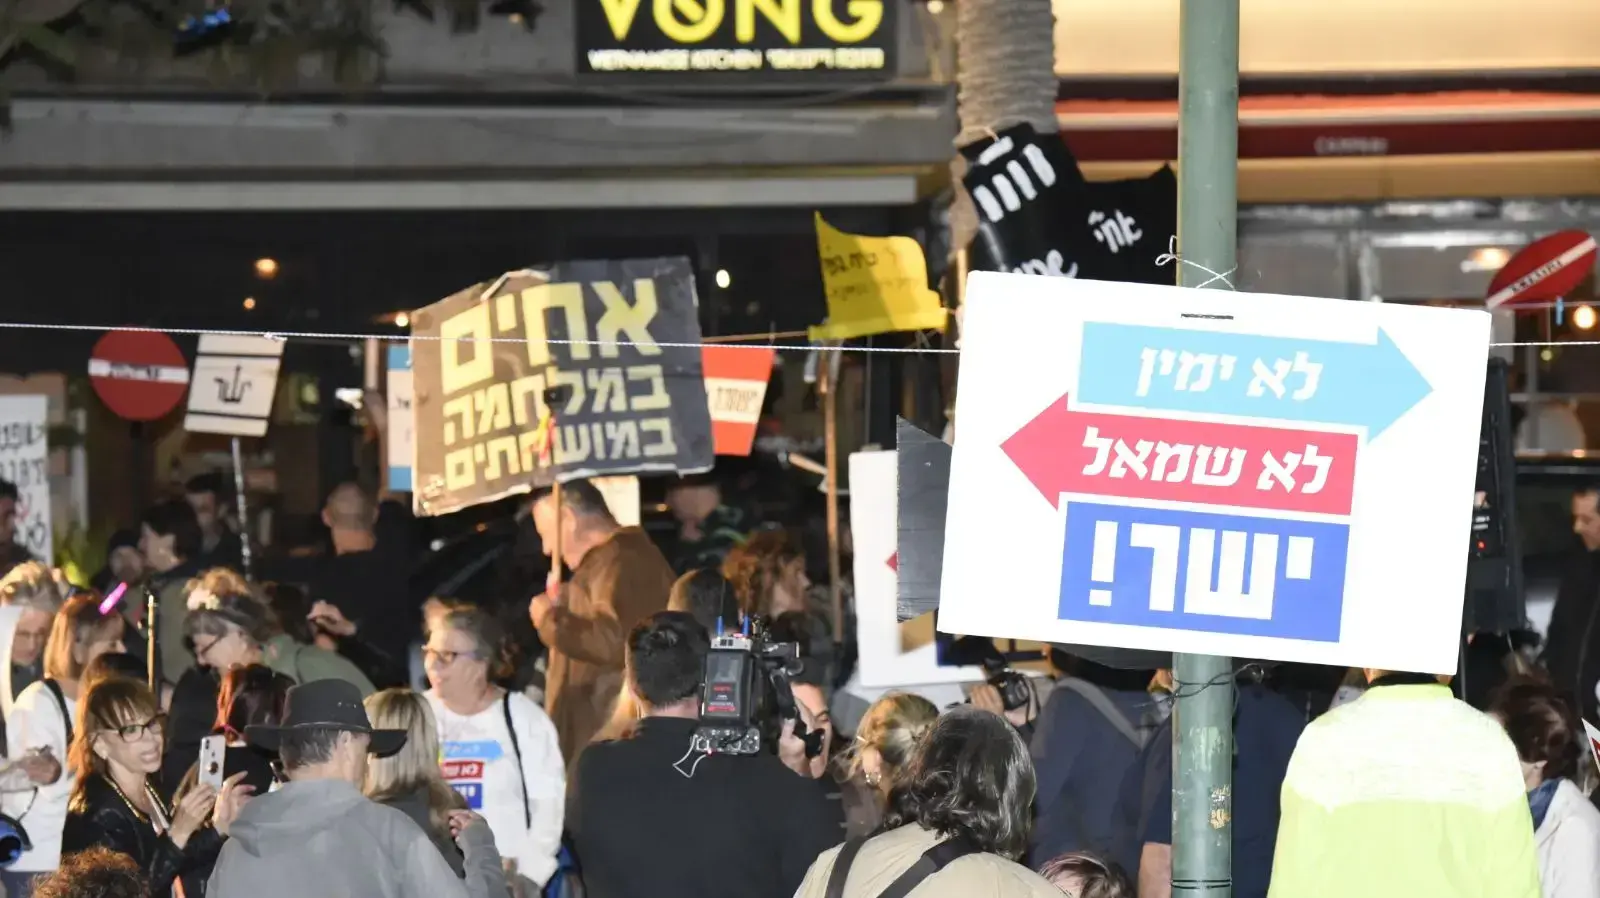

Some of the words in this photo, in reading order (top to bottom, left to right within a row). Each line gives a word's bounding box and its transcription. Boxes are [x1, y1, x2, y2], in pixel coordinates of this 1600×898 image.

[601, 0, 883, 43] VONG
[440, 278, 663, 395] אחים
[1135, 347, 1237, 397] ימין
[1245, 351, 1325, 404] לא
[443, 364, 672, 446] במלחמה
[445, 417, 678, 491] במושחתים
[1081, 426, 1248, 488] שמאל
[1256, 444, 1333, 494] לא
[1088, 520, 1314, 621] ישר!
